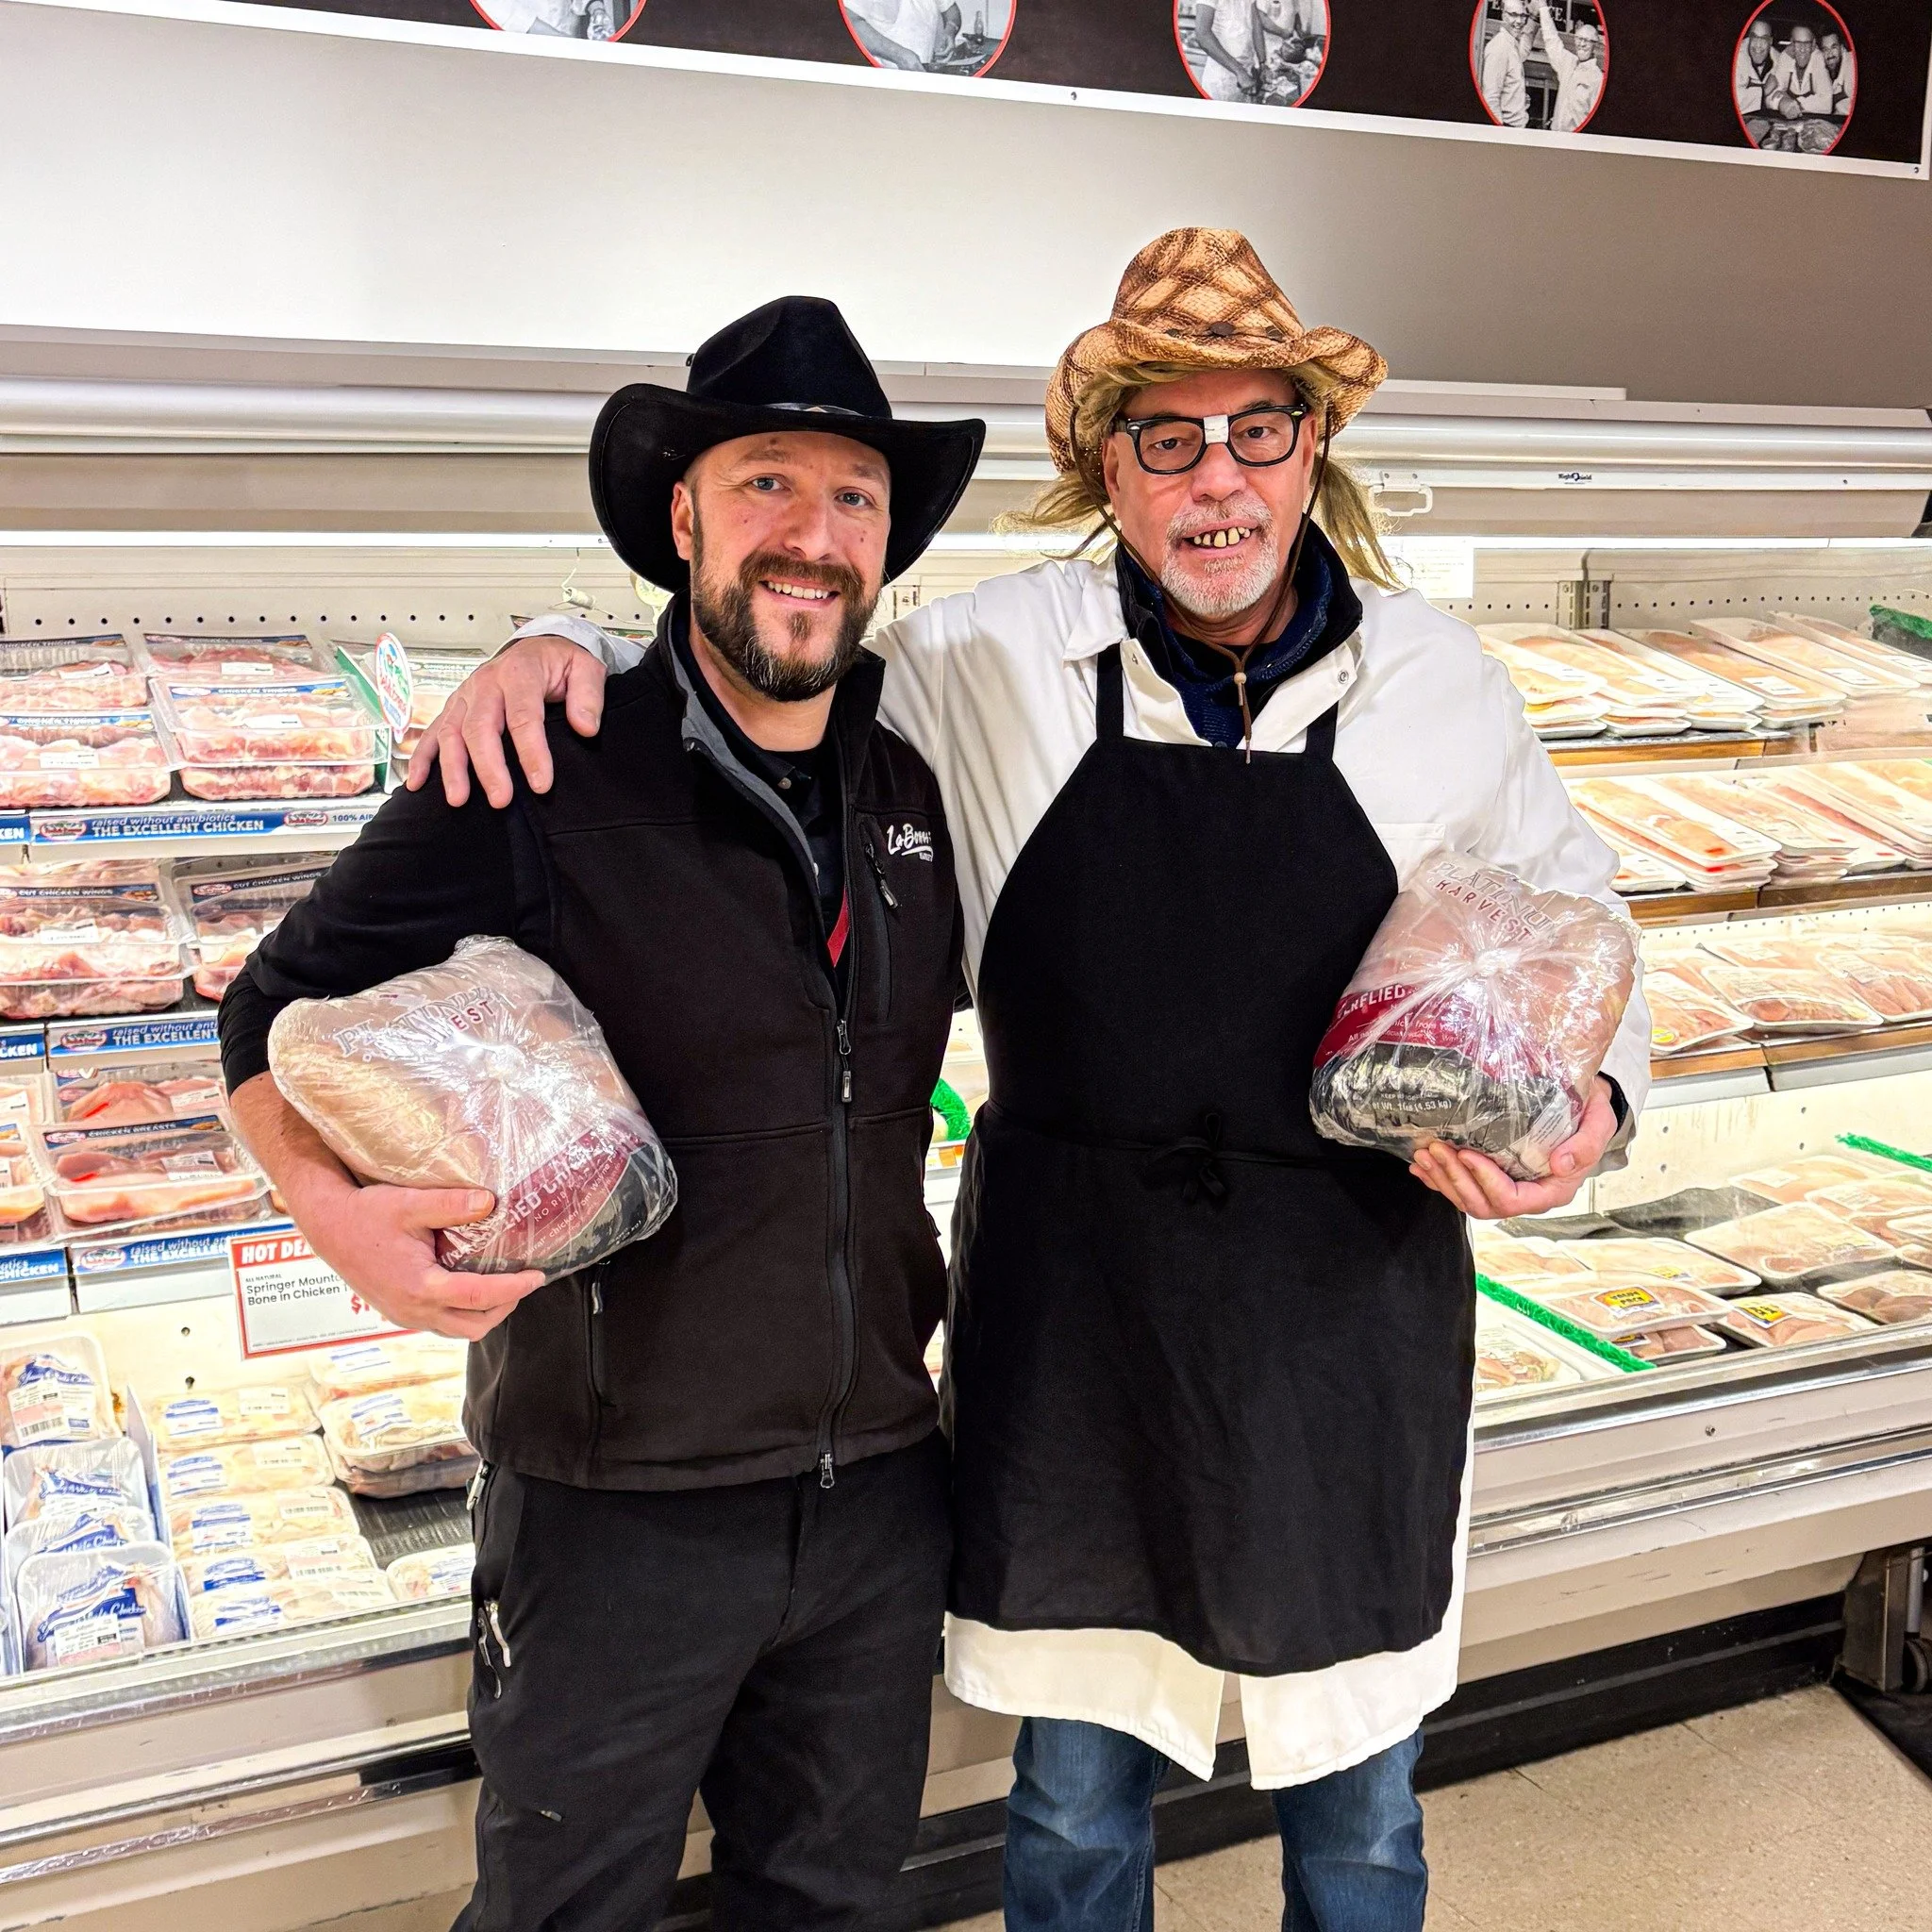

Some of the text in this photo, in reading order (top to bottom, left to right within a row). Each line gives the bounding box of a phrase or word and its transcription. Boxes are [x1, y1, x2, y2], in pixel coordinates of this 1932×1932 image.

[92, 814, 236, 828] raised without antibiotics
[92, 825, 120, 838] THE
[124, 823, 199, 836] EXCELLENT
[203, 820, 264, 833] CHICKEN
[1435, 879, 1534, 942] HARVEST
[112, 1024, 148, 1037] raised
[151, 1022, 193, 1033] without
[113, 1035, 141, 1046] THE
[1437, 1098, 1452, 1110] kg)
[533, 1208, 550, 1223] NO
[549, 1209, 580, 1238] chicken
[129, 1241, 166, 1256] raised
[168, 1238, 210, 1251] without
[242, 1243, 277, 1264] HOT
[130, 1252, 159, 1264] THE
[246, 1279, 295, 1296] Springer
[247, 1295, 277, 1307] Bone
[280, 1291, 291, 1301] in
[292, 1285, 341, 1300] Chicken
